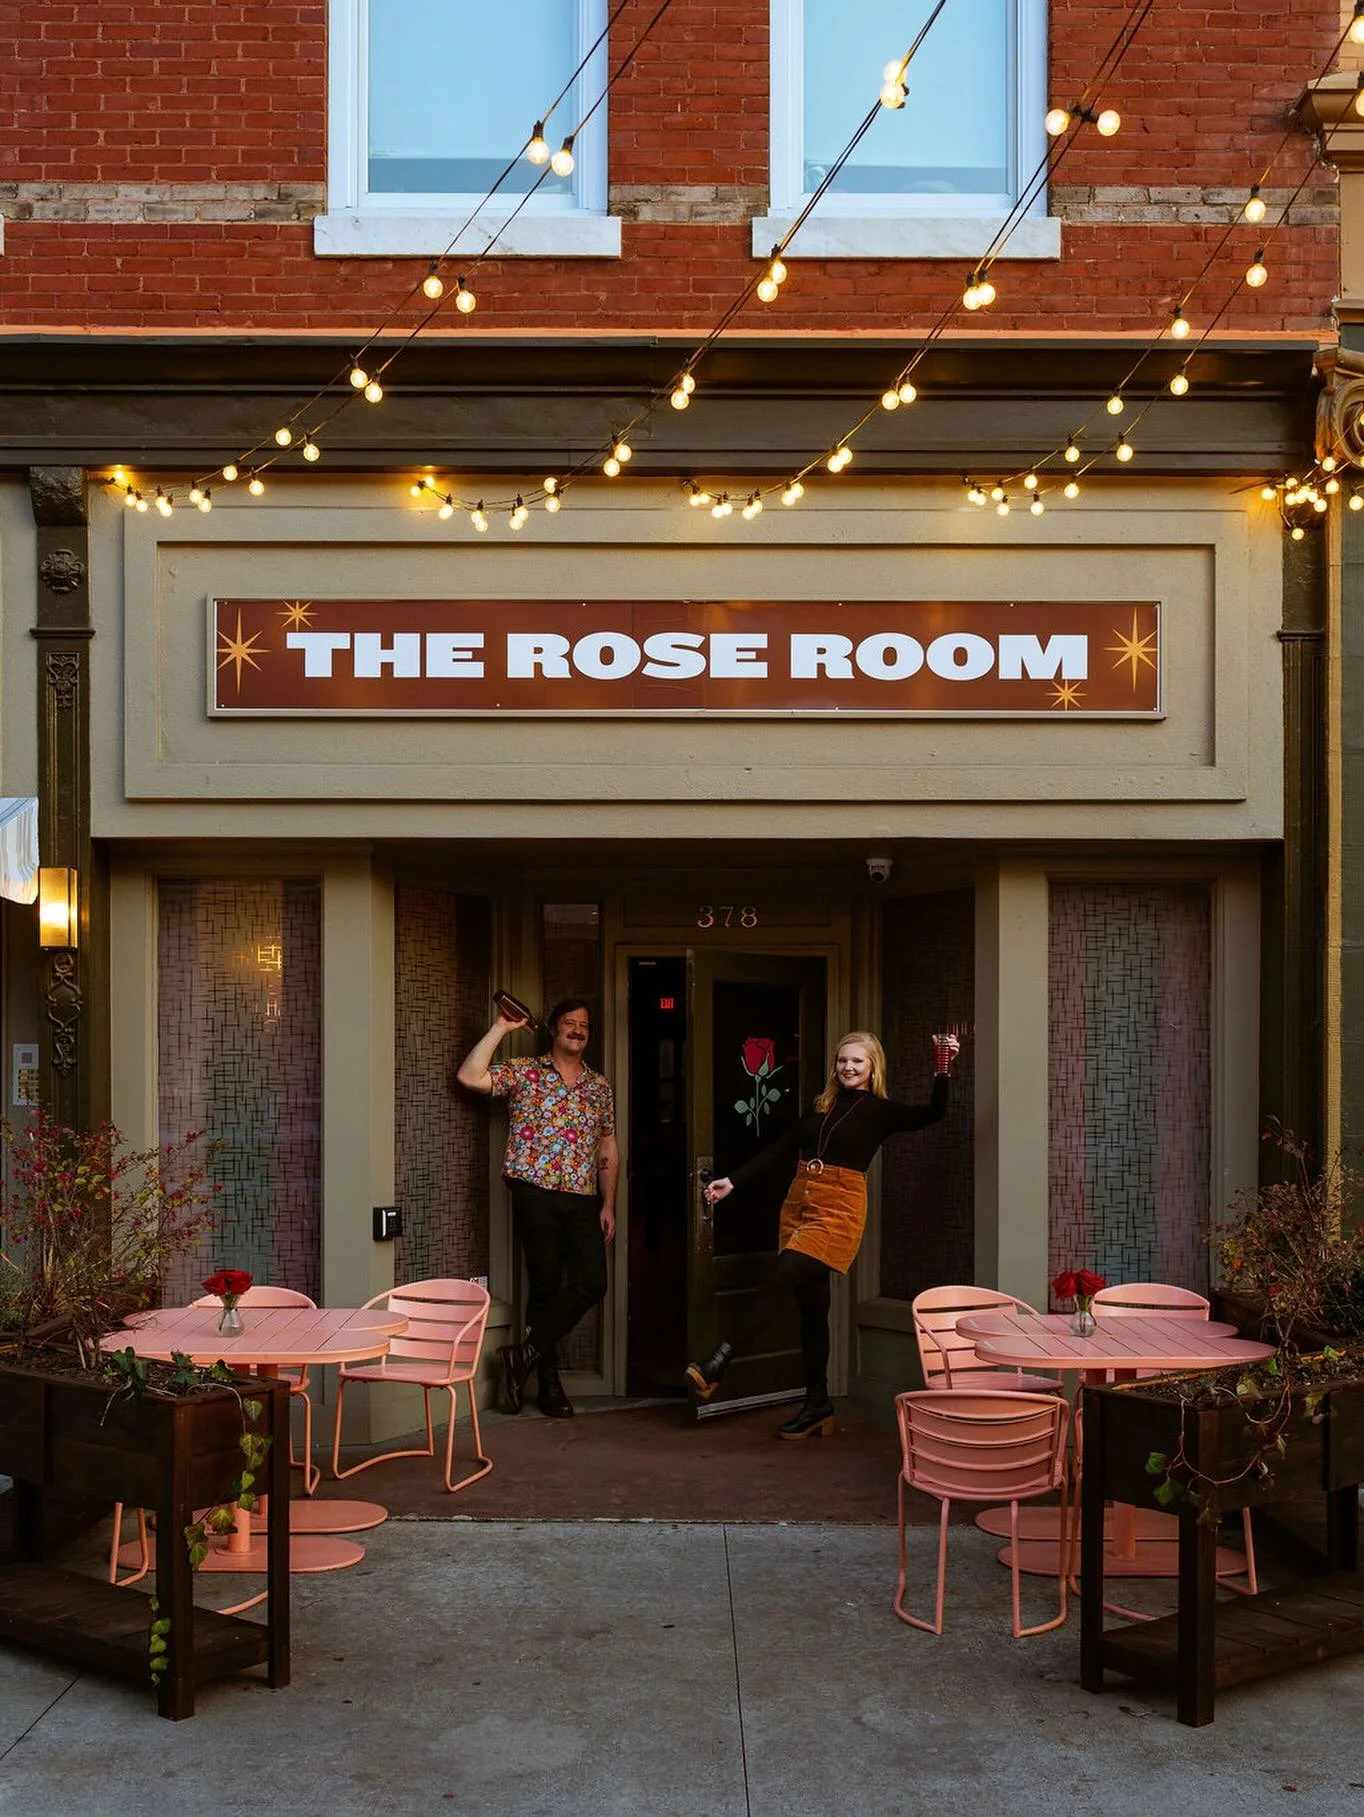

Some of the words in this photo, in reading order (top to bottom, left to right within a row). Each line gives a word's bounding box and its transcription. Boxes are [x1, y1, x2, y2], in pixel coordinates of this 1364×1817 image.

[286, 632, 485, 678] THE
[507, 632, 768, 680] ROSE
[790, 632, 1089, 681] ROOM
[697, 904, 758, 929] 378
